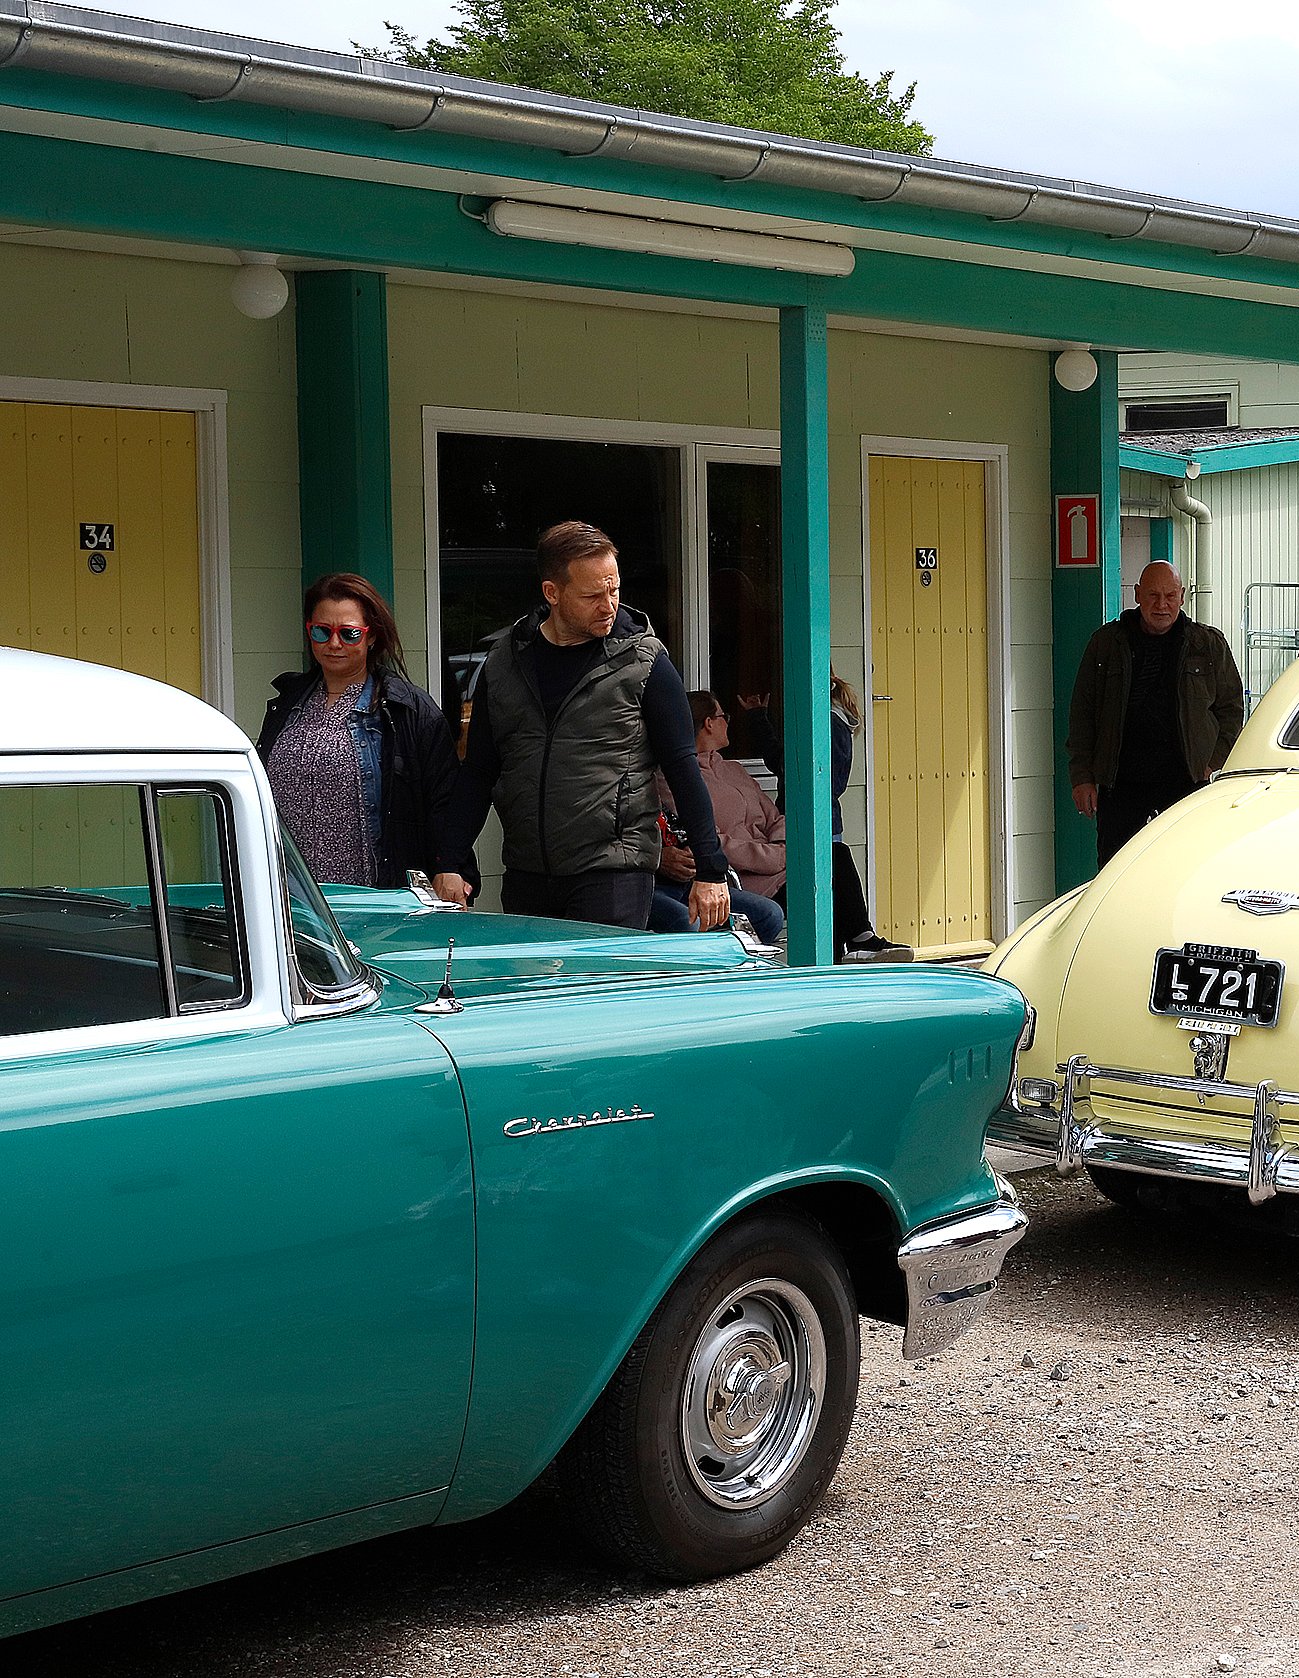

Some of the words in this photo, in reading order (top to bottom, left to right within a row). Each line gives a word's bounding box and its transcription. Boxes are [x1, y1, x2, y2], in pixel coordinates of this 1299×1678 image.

[84, 525, 112, 549] 34
[918, 549, 936, 568] 36
[1188, 944, 1253, 959] GRIFFITH
[1171, 963, 1189, 990] L
[1198, 966, 1257, 1009] 721
[1181, 1004, 1244, 1019] MICHIGAN
[503, 1103, 655, 1138] Chevrolet
